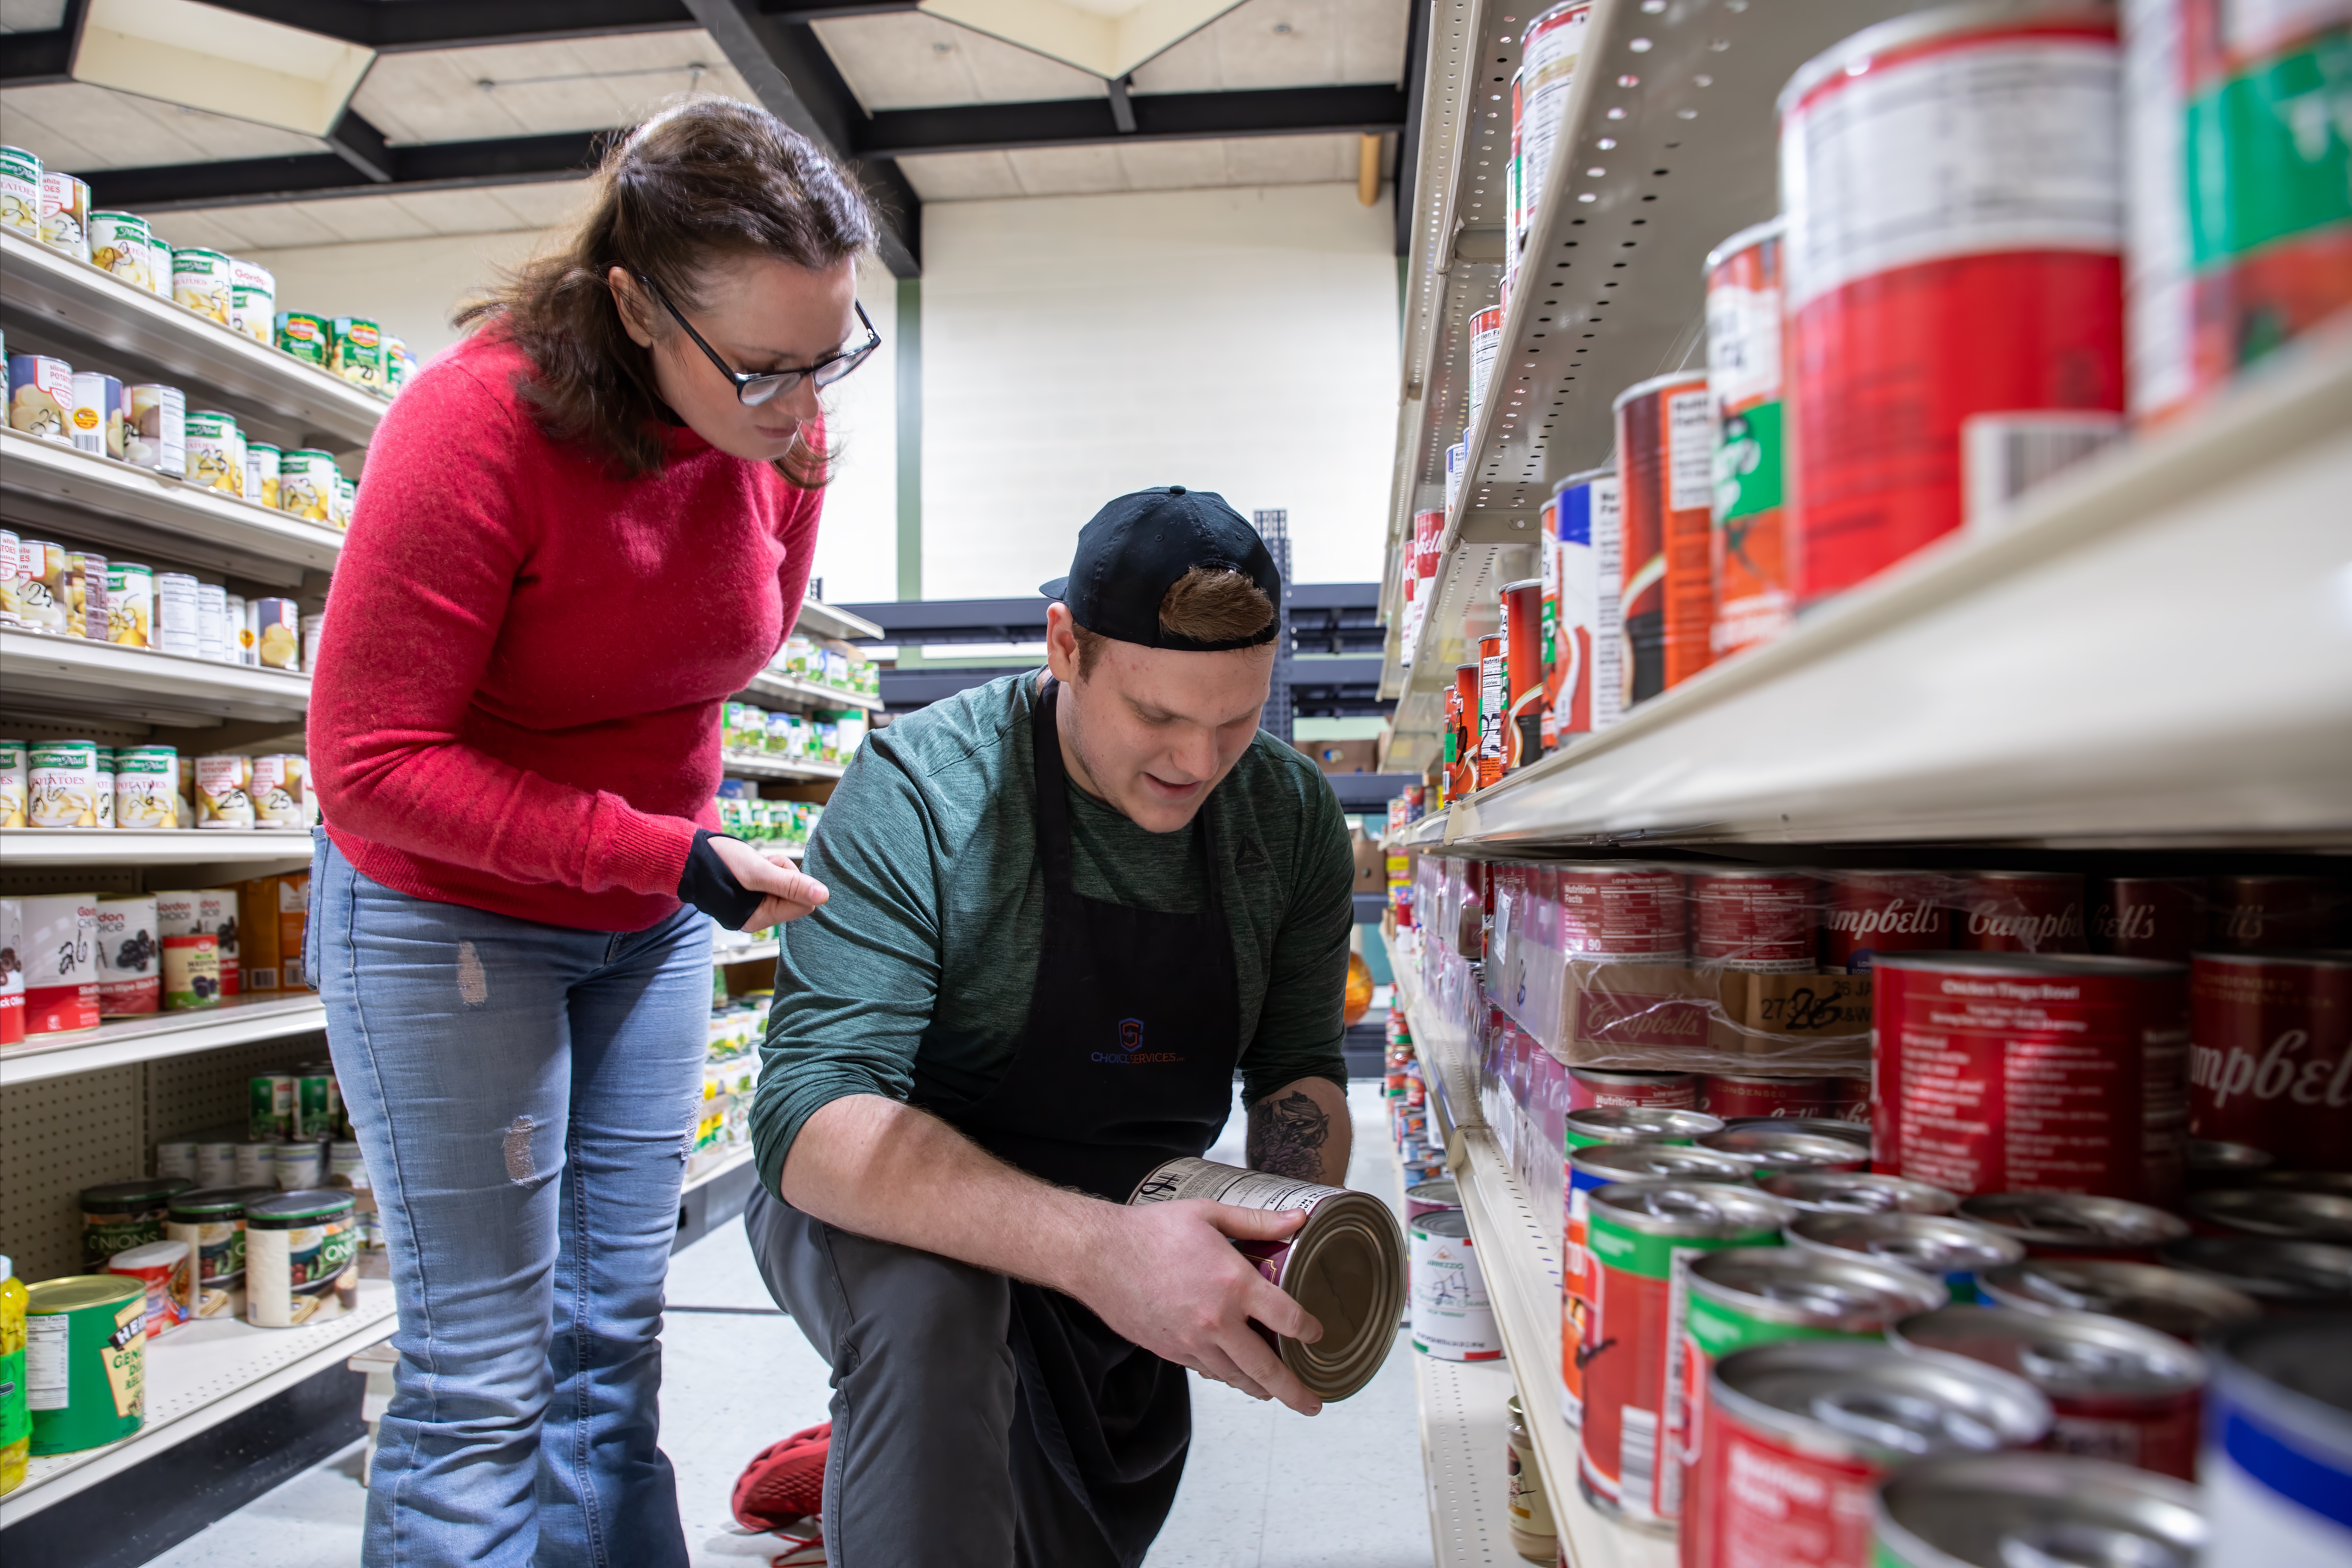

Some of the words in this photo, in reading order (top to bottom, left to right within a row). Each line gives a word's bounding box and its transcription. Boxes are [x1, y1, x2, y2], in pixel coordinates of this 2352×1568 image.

[31, 776, 85, 785] POTATOES
[270, 793, 290, 810] 25
[1564, 884, 1597, 894] Nutrition
[1564, 894, 1583, 903] Facts
[98, 912, 124, 922] don
[1588, 939, 1602, 951] 90
[1785, 988, 1842, 1030] 26
[1595, 1095, 1637, 1108] Nutrition
